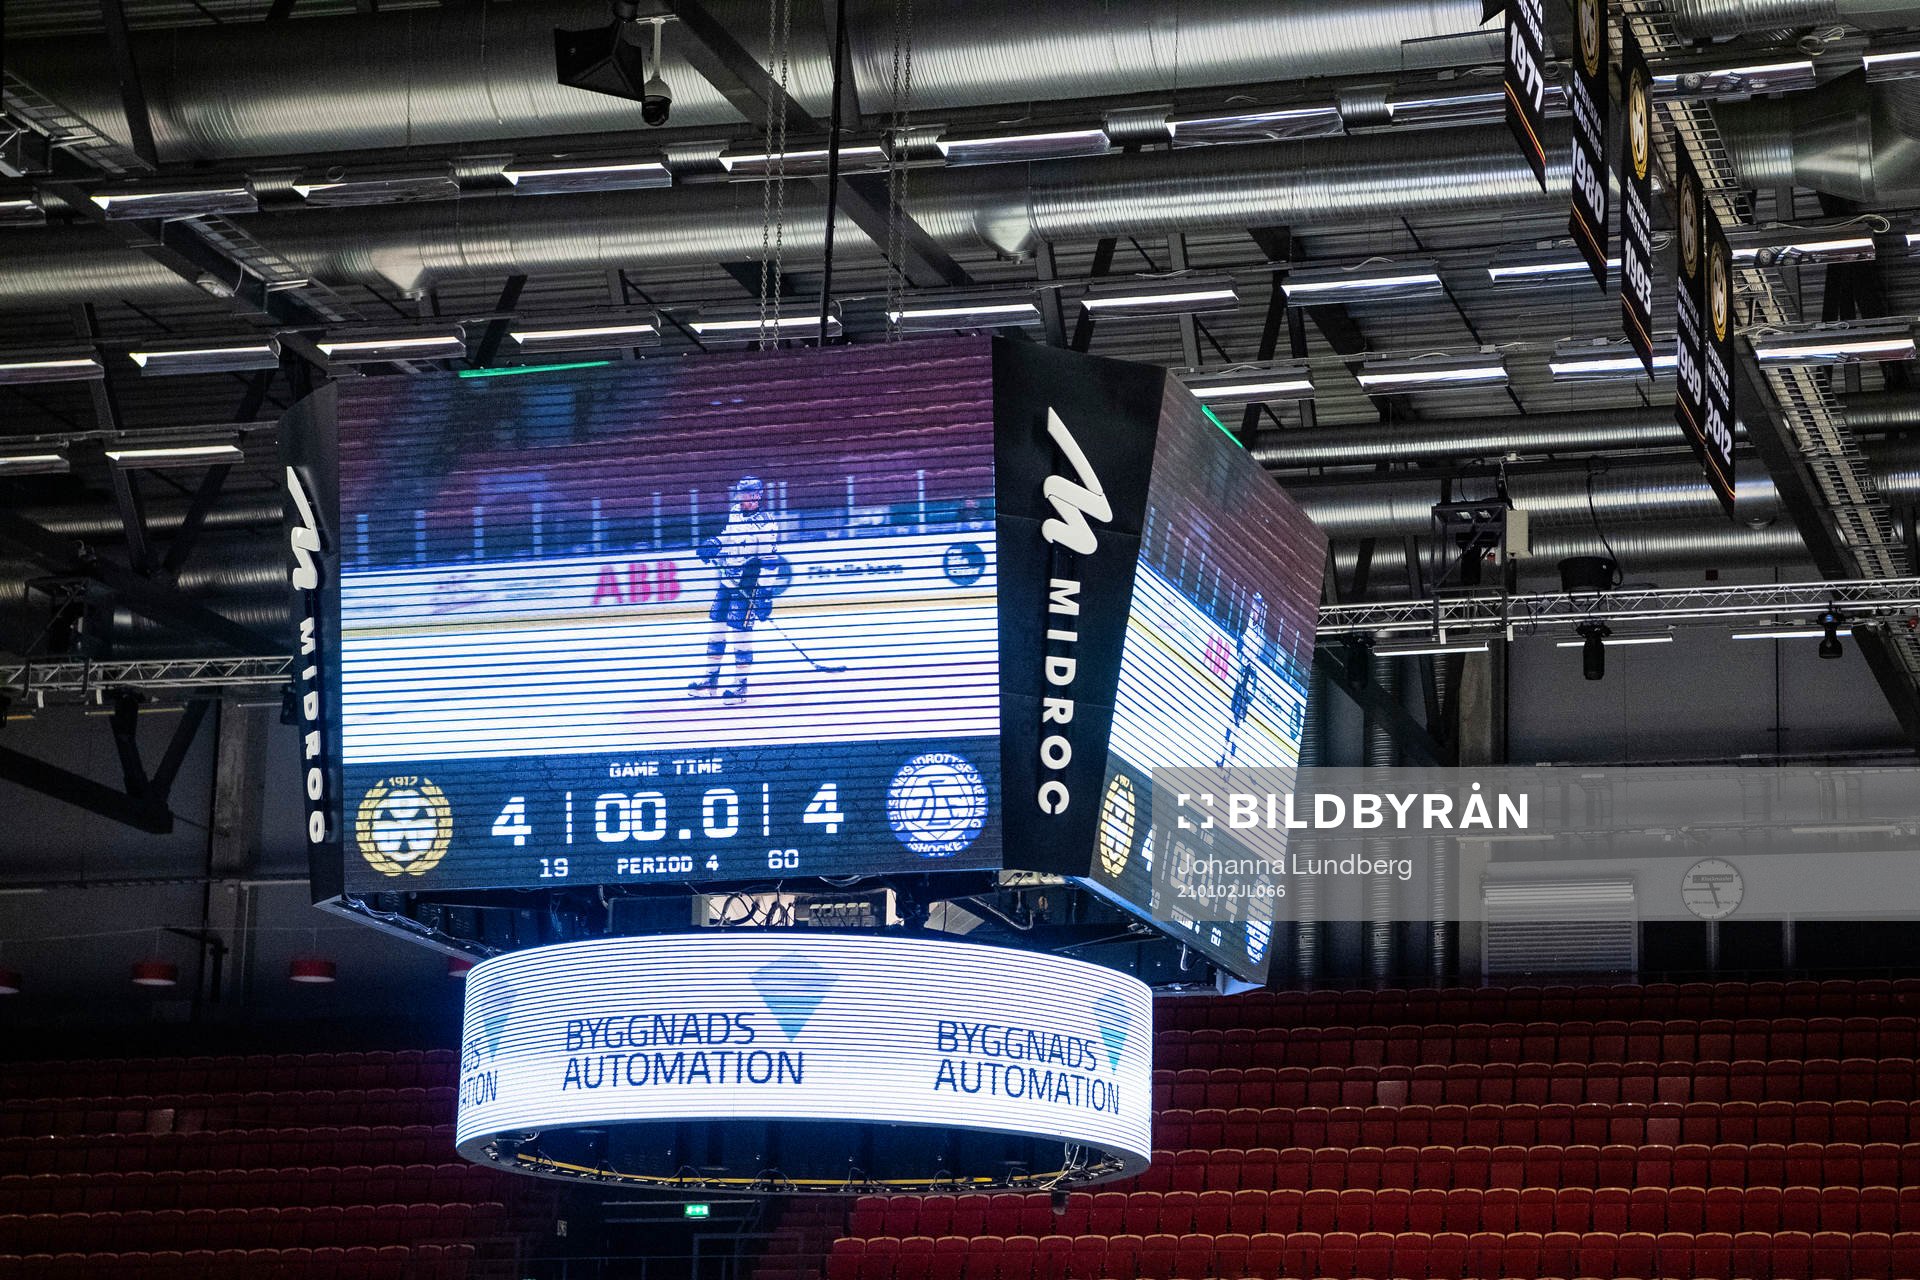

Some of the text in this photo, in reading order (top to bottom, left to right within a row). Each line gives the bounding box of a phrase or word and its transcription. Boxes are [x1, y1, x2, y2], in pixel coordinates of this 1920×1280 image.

[1510, 20, 1543, 112] 1977
[1574, 70, 1602, 136] SVENSKA
[1572, 136, 1605, 225] 1980
[1627, 176, 1651, 233] SVENSKA
[1625, 238, 1652, 315] 1993
[1705, 397, 1732, 465] 2012
[592, 559, 682, 604] ABB
[1037, 578, 1080, 815] MIDROC
[610, 758, 723, 778] GAME TIME
[491, 796, 532, 846] 4
[803, 783, 844, 834] 4
[539, 857, 568, 878] 19
[617, 854, 719, 875] PERIOD 4
[768, 849, 799, 869] 60
[566, 1012, 756, 1051] BYGGNADS
[937, 1020, 1098, 1071] BYGGNADS
[563, 1050, 803, 1091] AUTOMATION
[934, 1058, 1120, 1115] AUTOMATION
